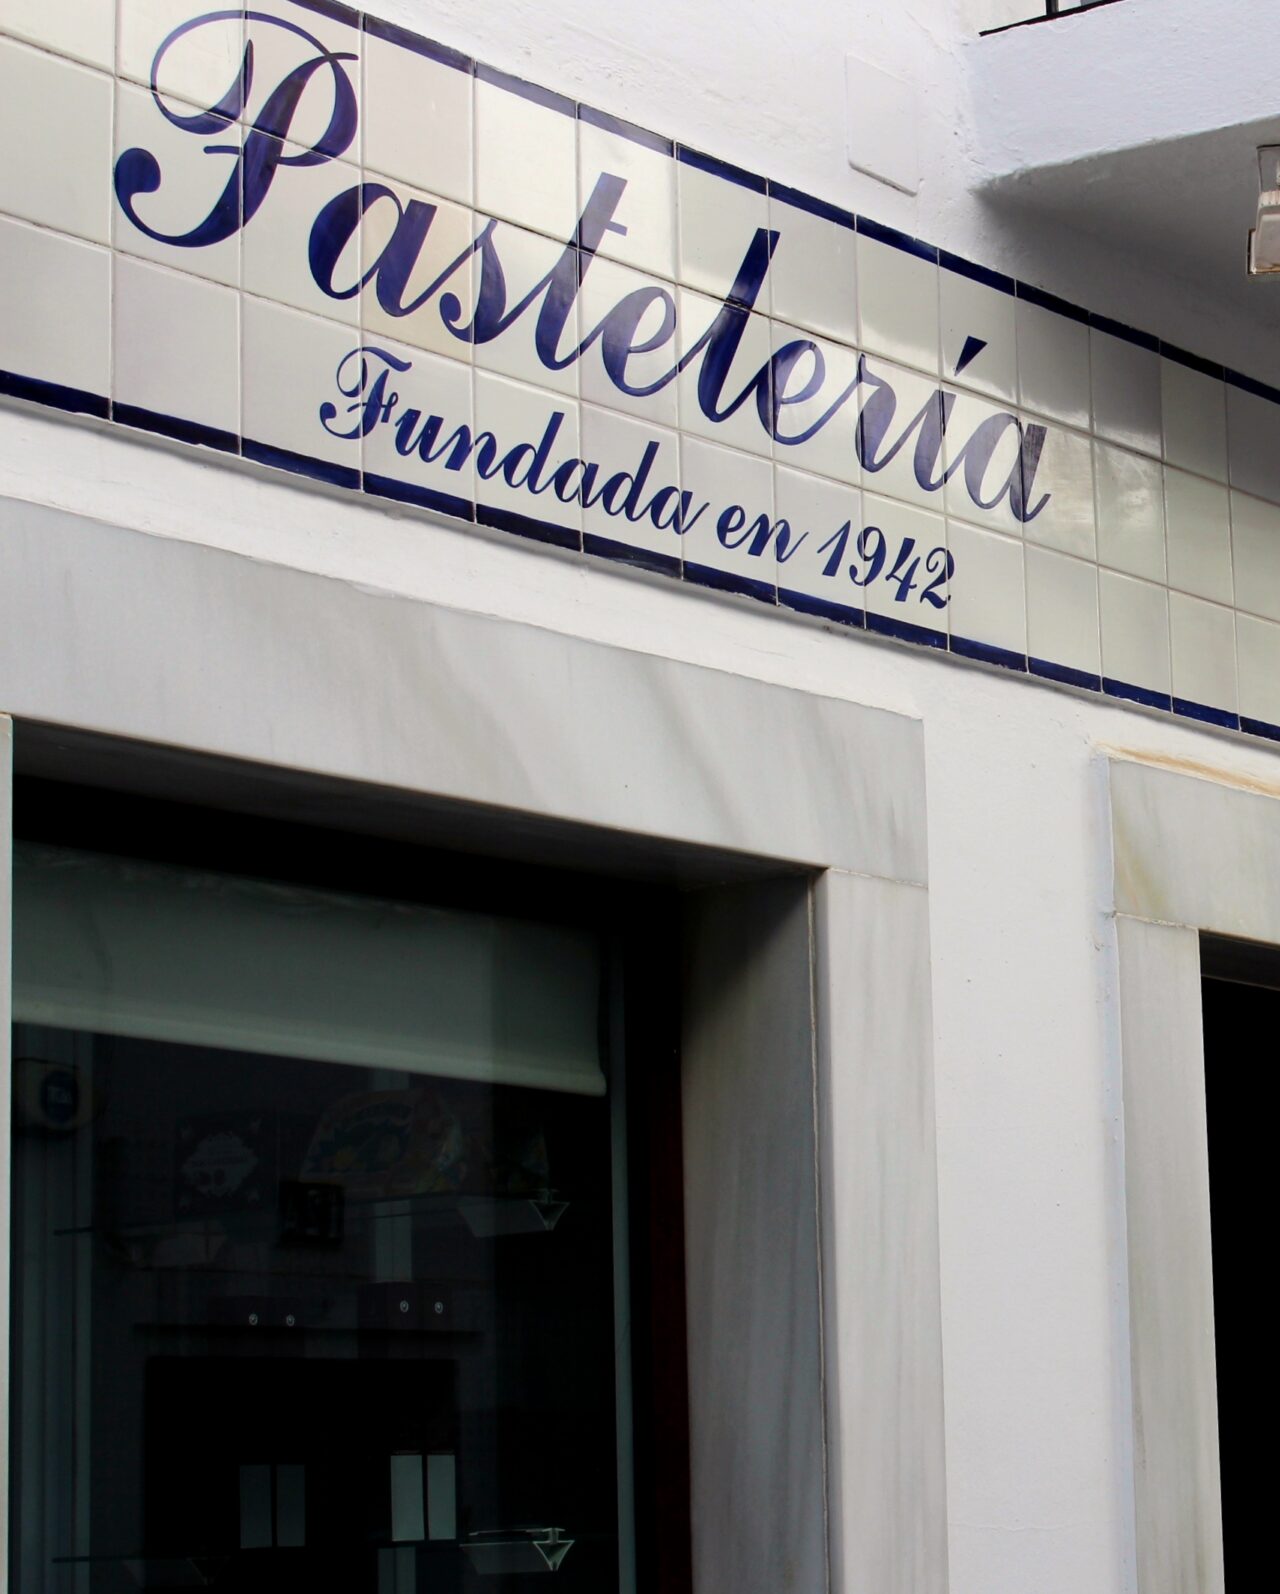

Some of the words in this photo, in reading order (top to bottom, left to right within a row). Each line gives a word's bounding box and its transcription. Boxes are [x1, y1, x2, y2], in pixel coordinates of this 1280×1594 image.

[114, 9, 1052, 524] Pastelería
[320, 345, 711, 539] Fundada
[716, 502, 807, 563] en
[817, 519, 957, 610] 1942
